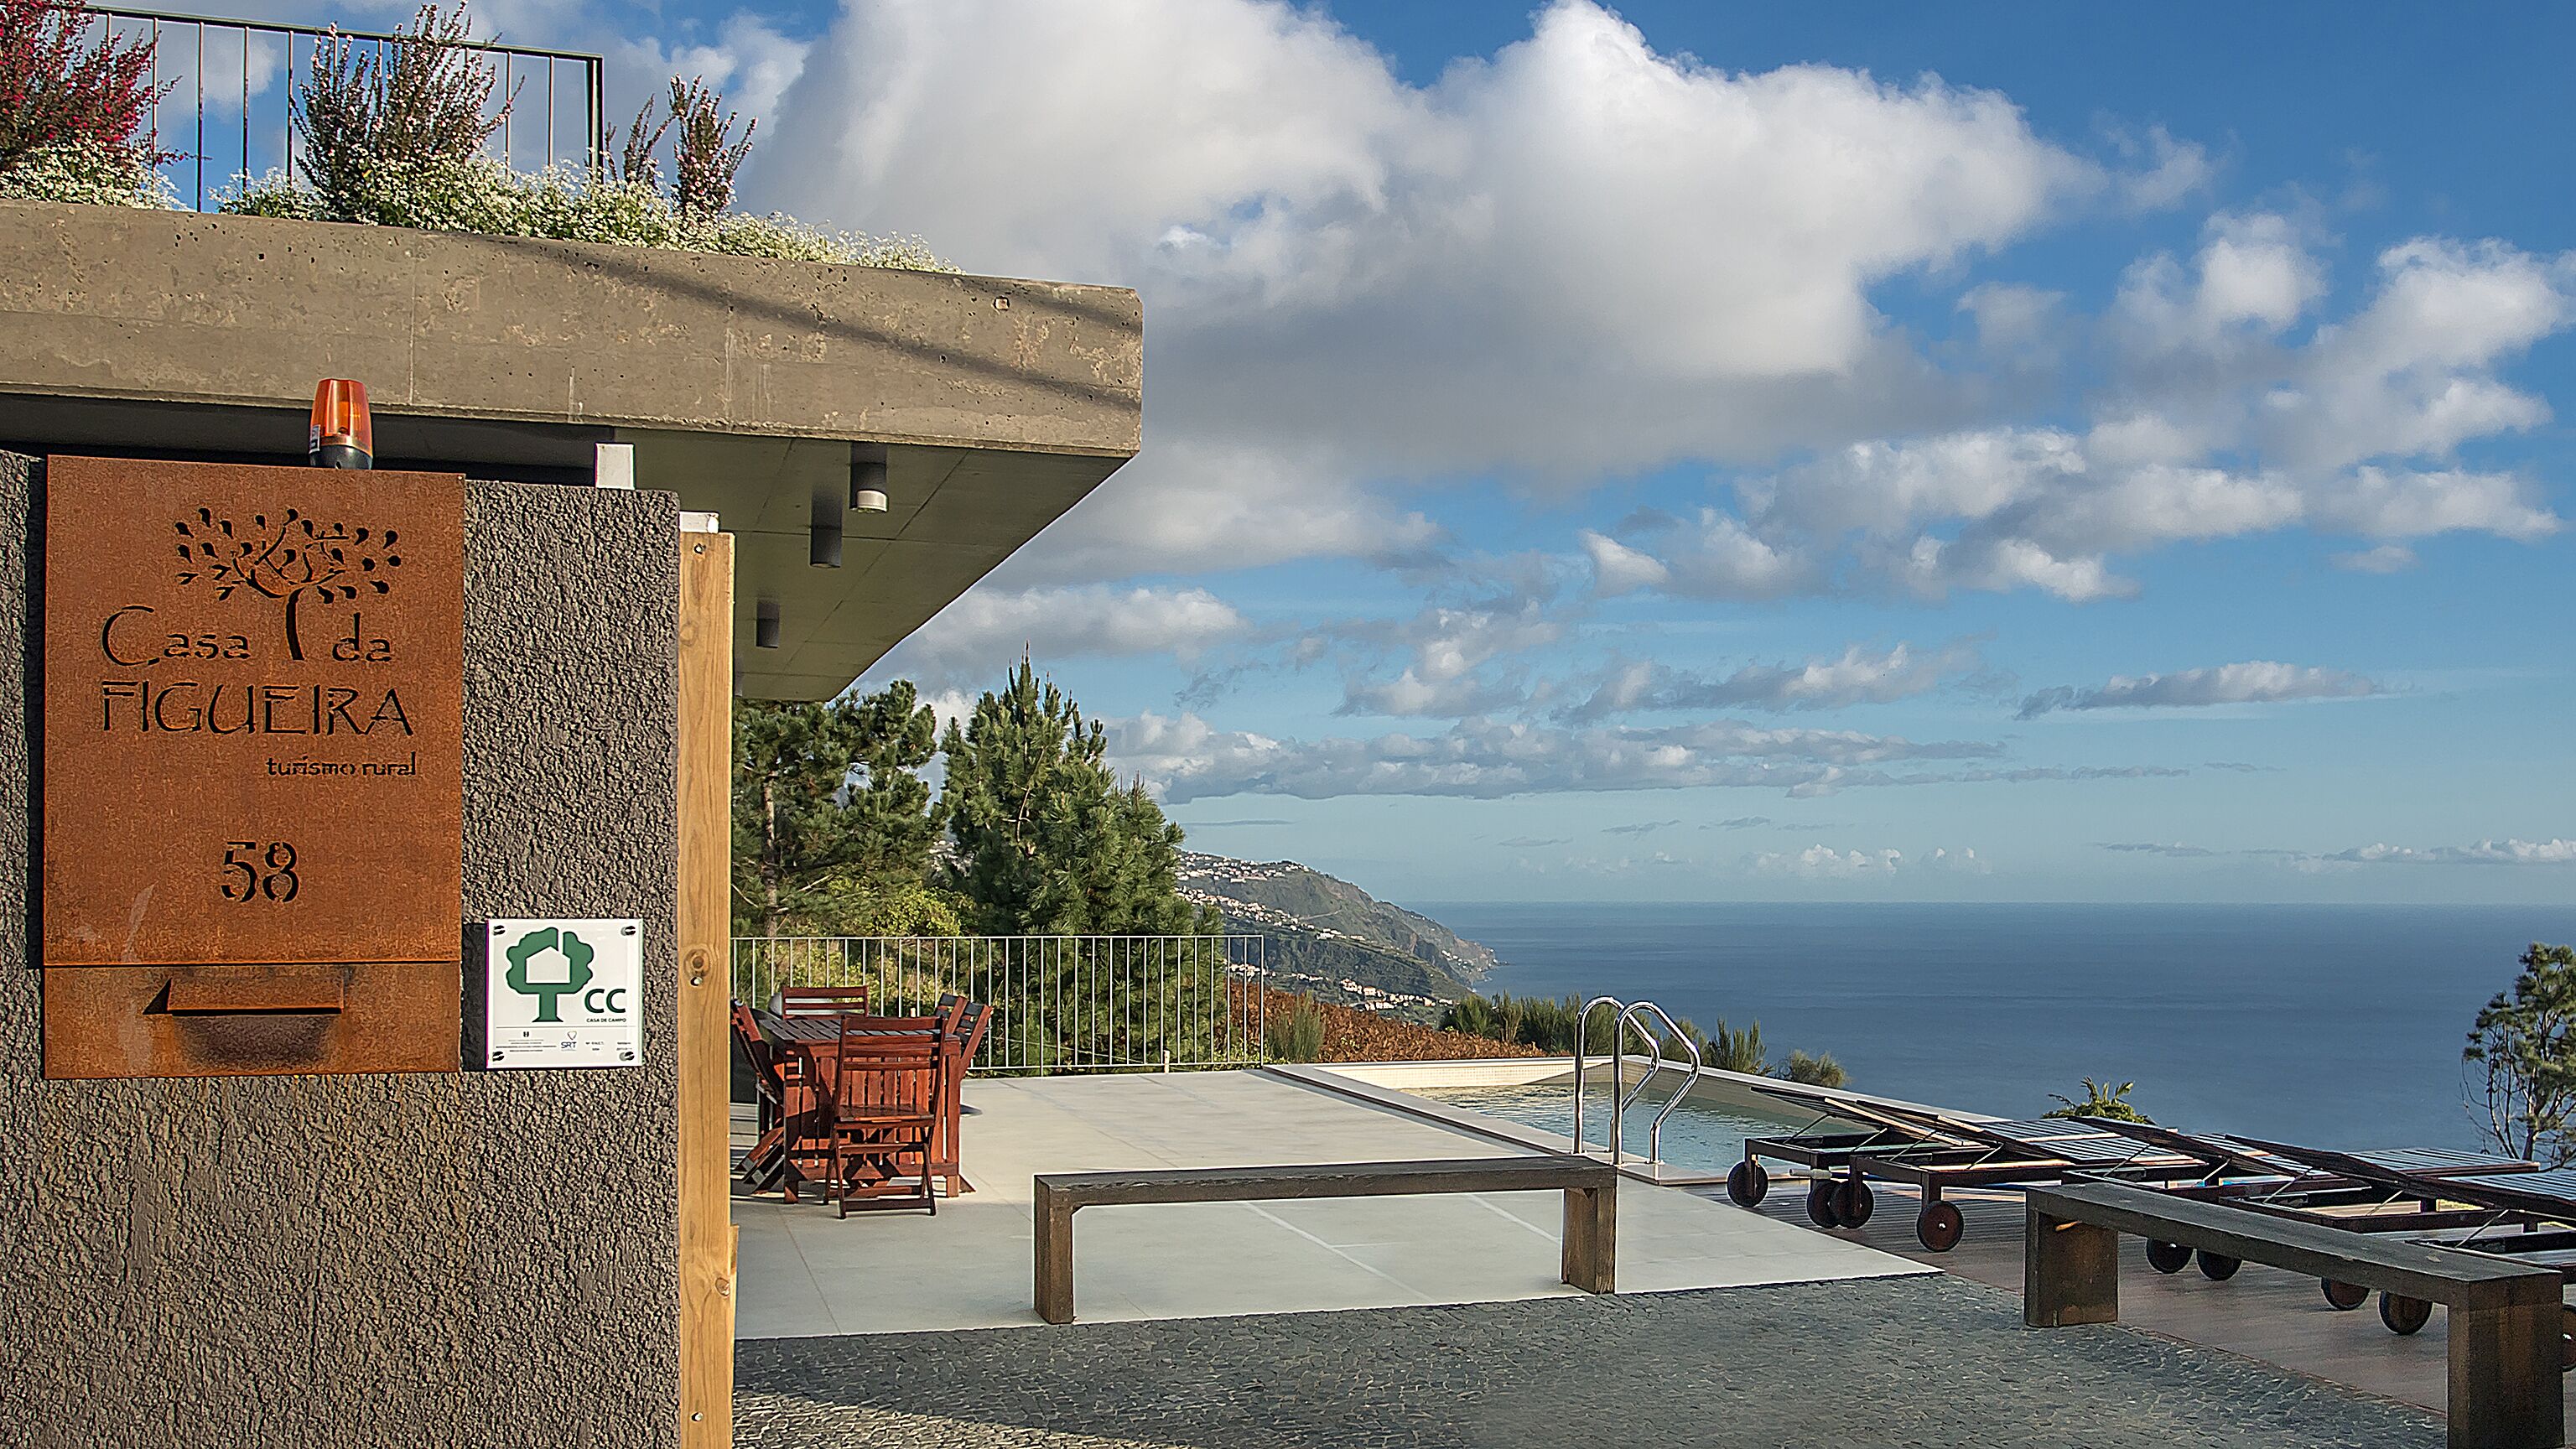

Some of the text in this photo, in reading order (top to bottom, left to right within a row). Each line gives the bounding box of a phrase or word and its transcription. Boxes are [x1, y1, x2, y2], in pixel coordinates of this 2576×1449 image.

[101, 605, 393, 667] Casa da
[101, 680, 414, 736] FIGUEIRA
[266, 751, 417, 776] turismo rural
[220, 841, 300, 903] 58
[584, 988, 627, 1014] CC
